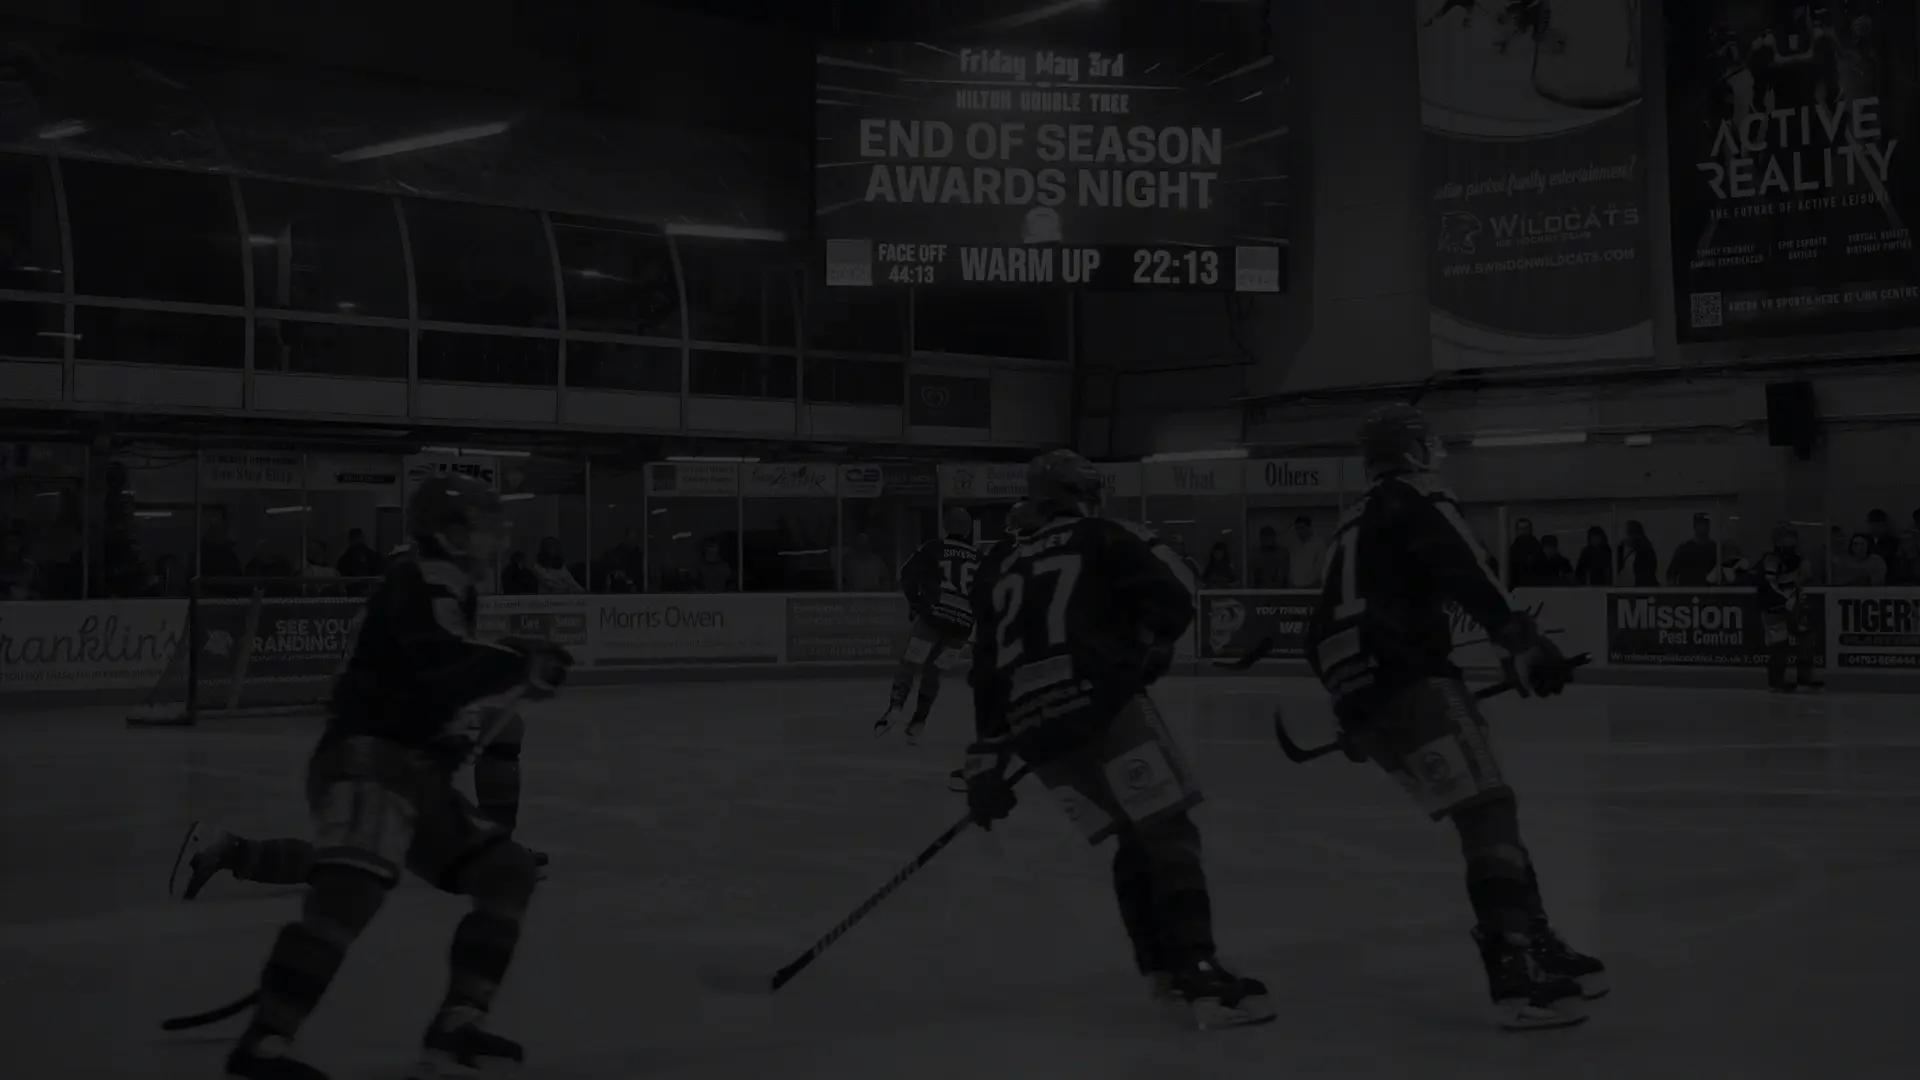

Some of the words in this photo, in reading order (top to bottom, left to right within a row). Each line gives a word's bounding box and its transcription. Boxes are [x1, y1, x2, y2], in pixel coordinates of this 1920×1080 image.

[960, 49, 1026, 80] Friday
[1036, 51, 1079, 81] May
[1088, 52, 1124, 77] 3rd
[956, 90, 1011, 111] HILTON
[1021, 91, 1080, 112] DOUBLE
[1089, 93, 1129, 113] TREE
[1710, 96, 1880, 157] ACTIVE
[860, 119, 954, 158] END
[965, 122, 1027, 160] OF
[1036, 124, 1221, 165] SEASON
[1507, 168, 1546, 198] family
[1696, 139, 1899, 200] REALITY
[864, 165, 1067, 206] AWARDS
[1079, 168, 1217, 209] NIGHT
[1490, 203, 1639, 238] WILDCATS
[1710, 208, 1729, 219] THE
[1734, 203, 1774, 217] FUTURE
[1779, 201, 1792, 213] OF
[1798, 196, 1836, 211] ACTIVE
[878, 244, 916, 261] FACE
[919, 245, 948, 262] OFF
[960, 247, 1053, 282] WARM
[1061, 248, 1100, 283] UP
[888, 265, 935, 284] 44:13
[1133, 249, 1219, 285] 22:13
[1762, 299, 1773, 310] VR
[1844, 292, 1854, 303] AT
[1881, 286, 1919, 300] CENTRE
[1173, 465, 1216, 491] What
[1265, 461, 1318, 488] Others
[600, 604, 661, 629] Morris
[665, 605, 724, 629] Owen
[992, 553, 1081, 669] 27
[1255, 605, 1277, 616] YOU
[1617, 595, 1743, 630] Mission
[0, 613, 177, 665] ranklin's
[275, 618, 310, 636] SEE
[313, 618, 354, 635] YOU
[1279, 621, 1303, 634] WE
[1658, 629, 1686, 646] Pest
[1693, 629, 1743, 646] Control
[251, 635, 338, 653] RANDING
